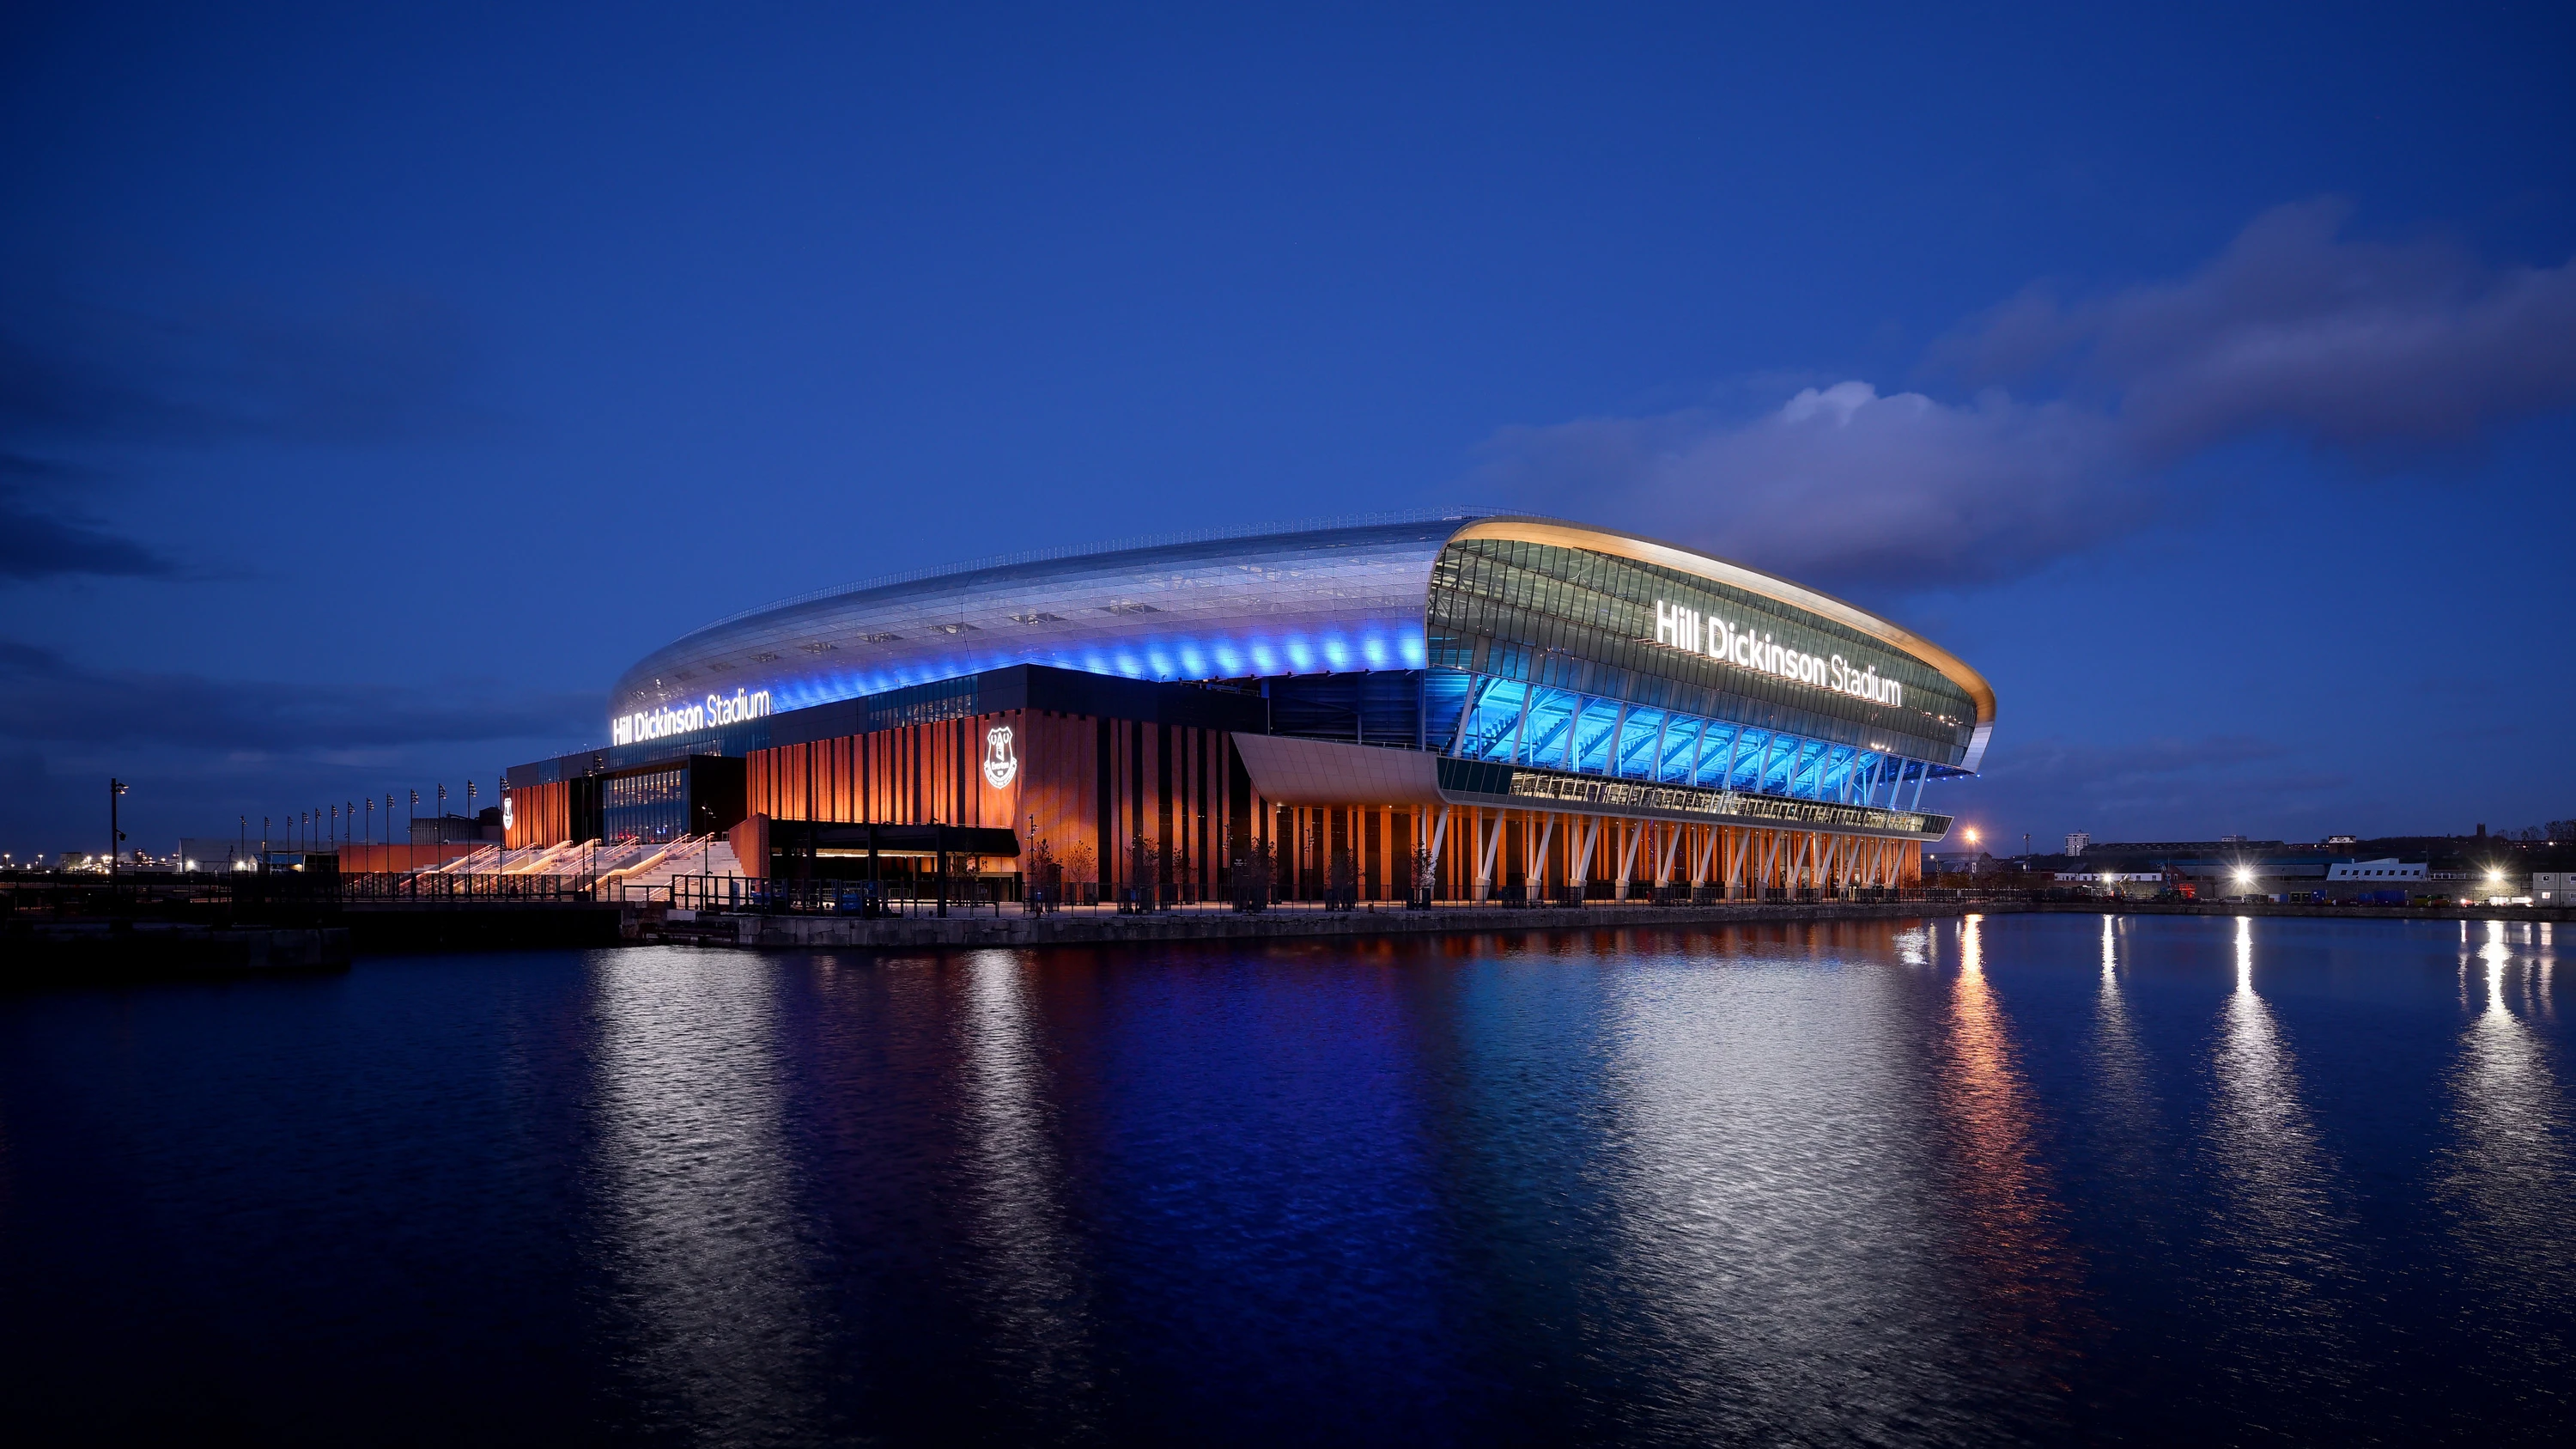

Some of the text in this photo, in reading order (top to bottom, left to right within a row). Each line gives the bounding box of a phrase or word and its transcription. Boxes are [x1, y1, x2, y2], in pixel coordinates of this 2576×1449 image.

[1656, 600, 1901, 707] Hill Dickinson Stadium
[613, 688, 770, 746] Hill Dickinson Stadium
